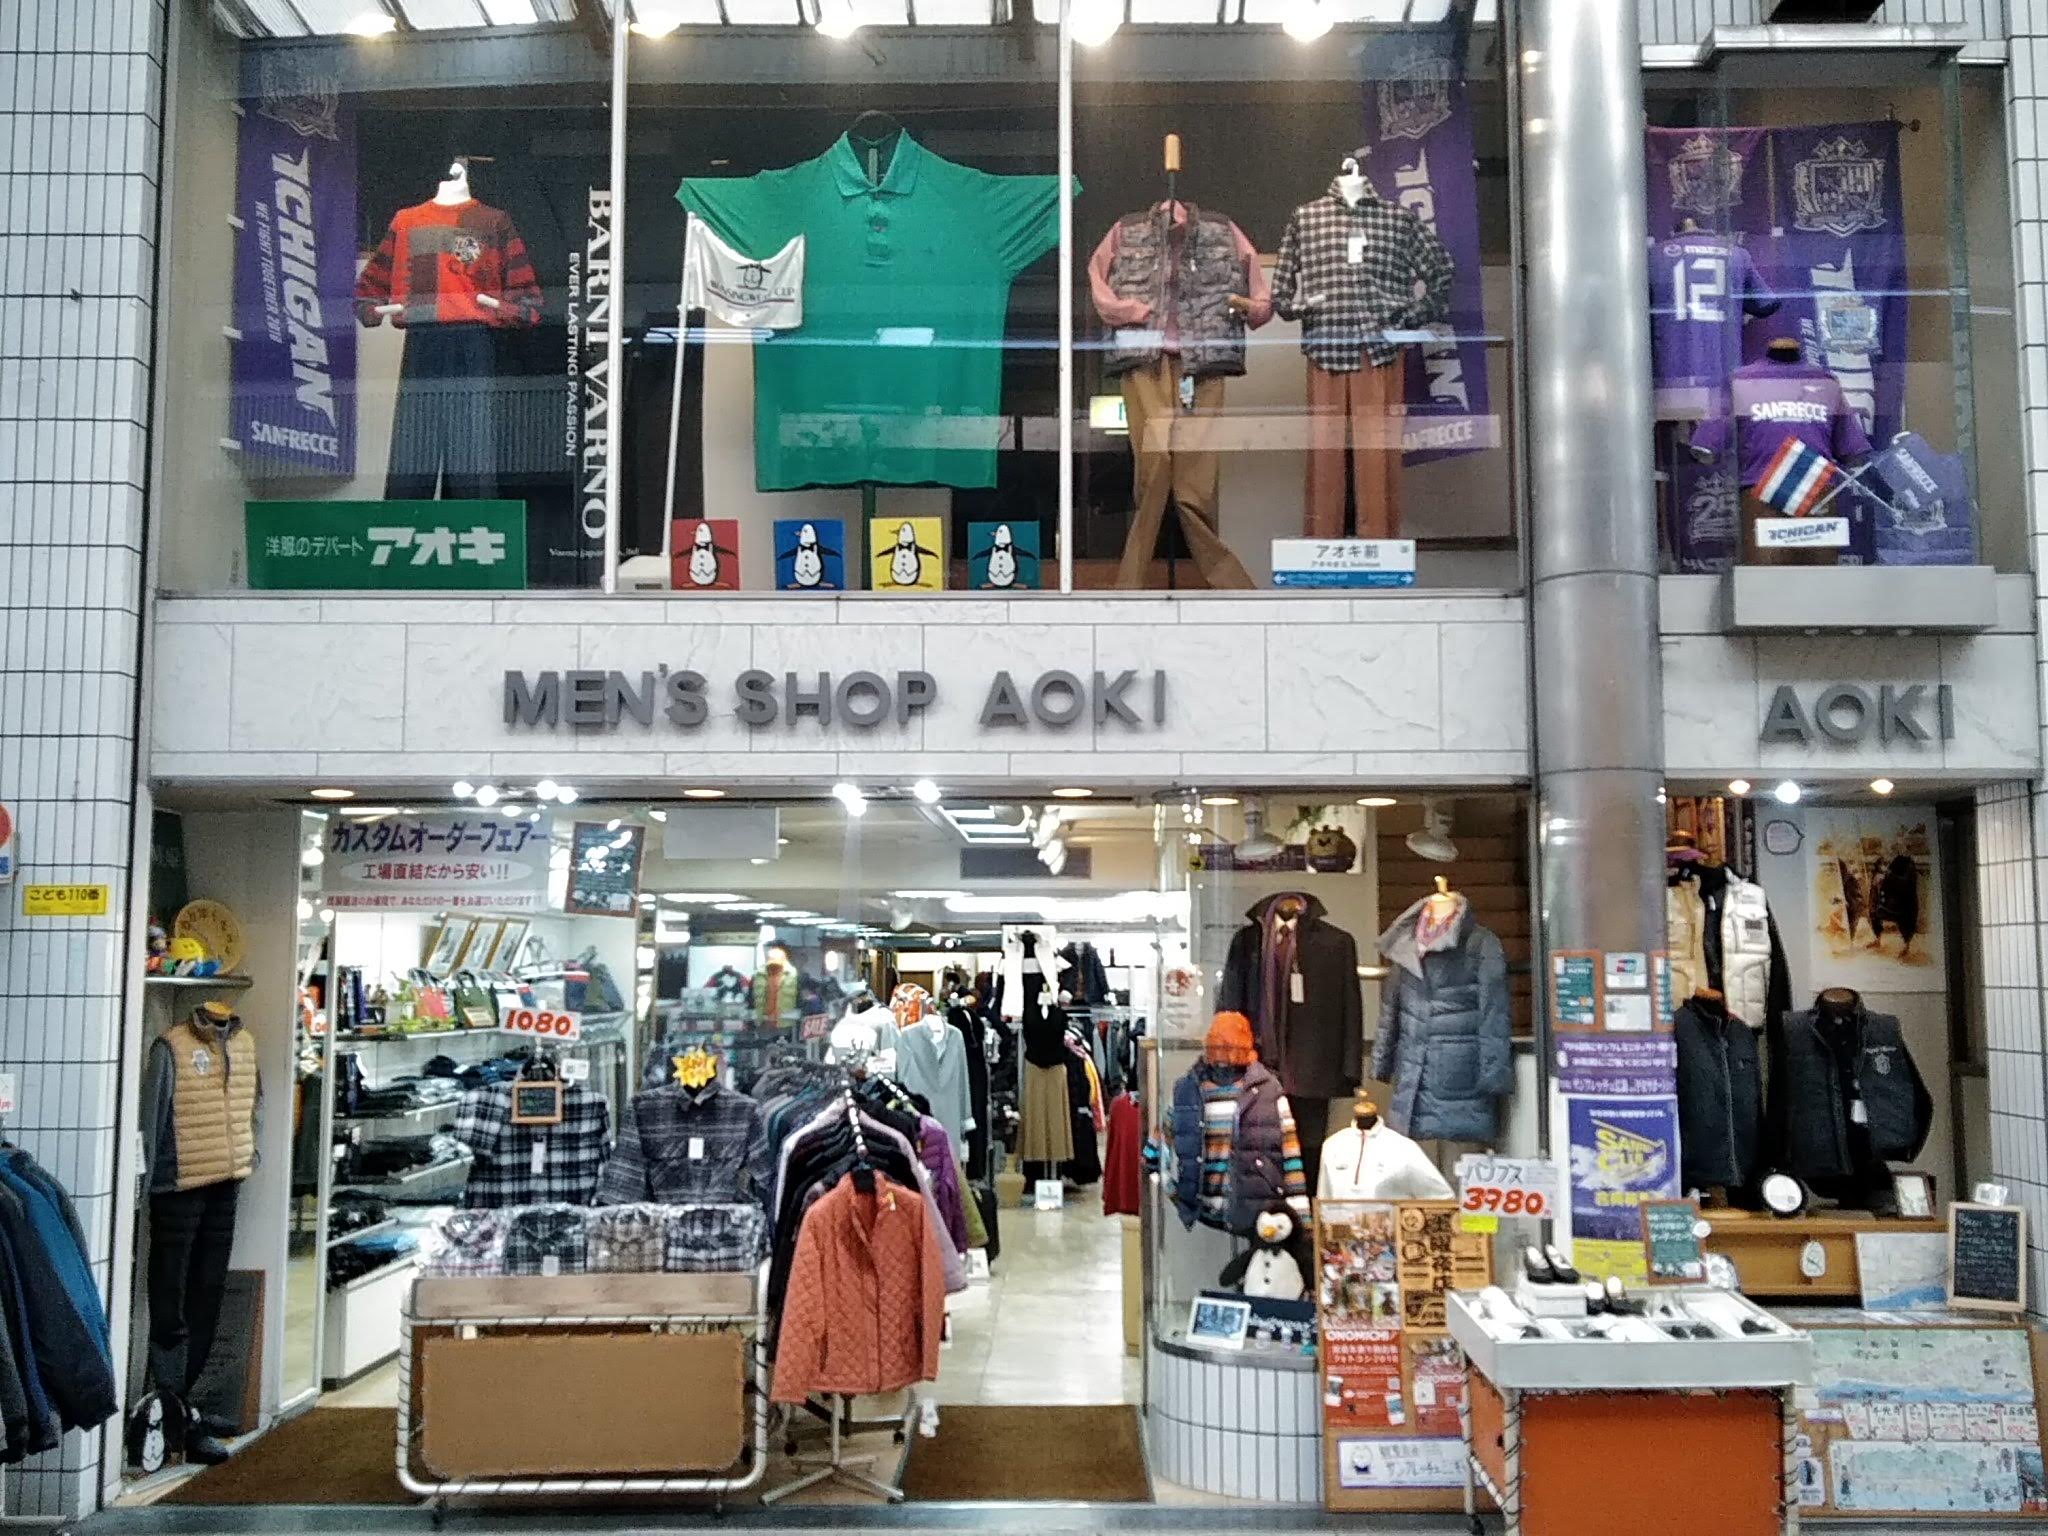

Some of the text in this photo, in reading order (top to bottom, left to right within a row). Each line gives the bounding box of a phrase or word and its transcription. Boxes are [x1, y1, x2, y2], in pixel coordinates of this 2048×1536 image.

[1673, 258, 1727, 321] 12
[565, 252, 581, 456] EVER LASTING PASSION
[1751, 401, 1828, 422] SANFRECCE
[251, 420, 339, 458] SANFRECCE
[581, 357, 609, 539] VARNO
[1401, 419, 1472, 447] ANFRECCE
[265, 536, 364, 557] 洋服のデパート
[367, 526, 506, 566] アオキ
[504, 663, 1166, 727] MEN'S SHOP AOKI
[1760, 684, 1956, 747] AOKI
[331, 821, 548, 853] カスタムオーダーフェアー
